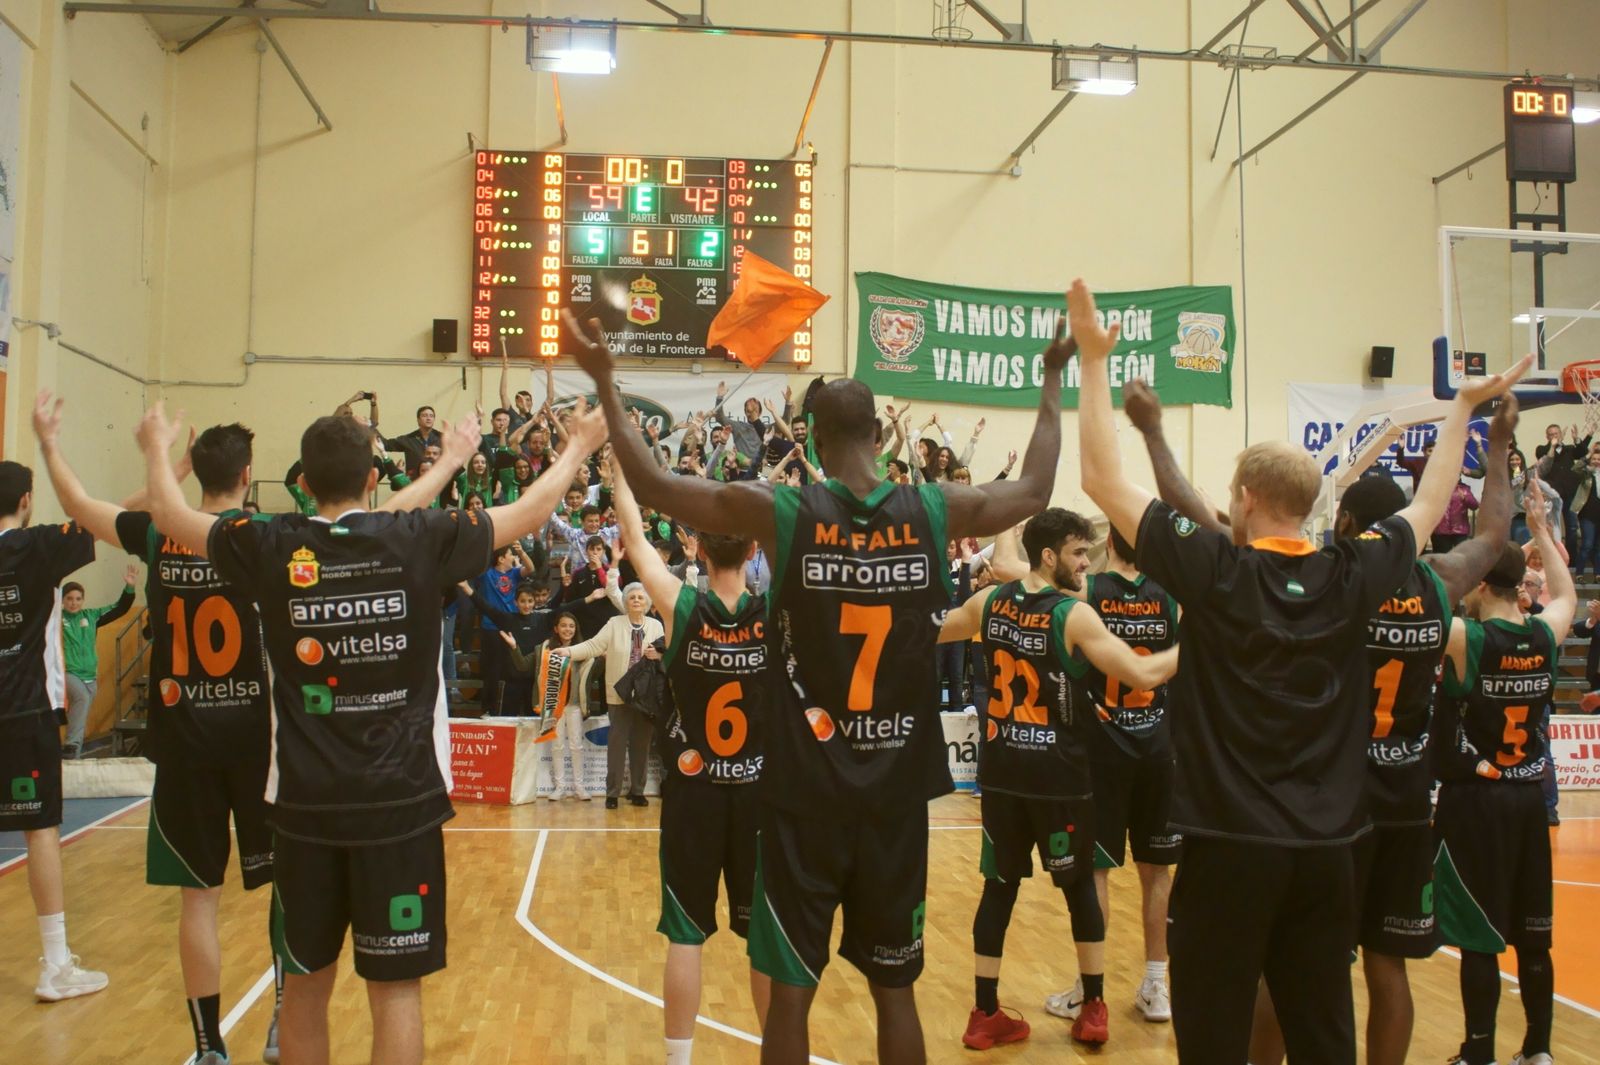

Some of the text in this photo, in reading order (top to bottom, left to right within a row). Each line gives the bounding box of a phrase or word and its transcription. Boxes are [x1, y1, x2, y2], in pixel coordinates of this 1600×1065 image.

[1554, 94, 1566, 114] 0
[477, 152, 494, 165] 01
[666, 160, 682, 184] 0
[729, 161, 811, 176] 03 05
[477, 169, 562, 185] 04 00
[476, 187, 493, 199] 05
[729, 178, 811, 193] 07 10
[589, 186, 623, 210] 59
[636, 186, 652, 212] E
[685, 188, 718, 212] 42
[729, 194, 811, 210] 09 16
[476, 203, 561, 219] 06 00
[582, 212, 610, 222] LOCAL
[630, 213, 656, 223] PARTE
[670, 214, 714, 224] VISITANTE
[734, 212, 811, 226] 10 00
[476, 220, 492, 232] 07
[480, 238, 491, 250] 10
[588, 228, 604, 254] 5
[632, 230, 649, 254] 6
[668, 231, 673, 255] 1
[700, 231, 719, 256] 2
[734, 229, 811, 244] 11 04
[572, 256, 598, 265] FALTAS
[733, 246, 810, 260] 12 03
[480, 256, 560, 270] 11 00
[618, 257, 644, 266] DORSAL
[654, 258, 673, 266] FALTA
[687, 259, 713, 268] FALTAS
[480, 272, 491, 284] 12
[479, 290, 490, 301] 14
[474, 306, 490, 319] 32
[934, 299, 1026, 338] VAMOS
[474, 324, 558, 338] 33 00
[604, 331, 690, 342] yuntamiento de
[473, 341, 558, 356] 99 00
[630, 344, 644, 353] de
[646, 344, 656, 354] la
[660, 344, 706, 354] Frontera
[932, 348, 1024, 388] VAMOS
[162, 566, 218, 582] arron
[807, 562, 924, 584] arrones
[294, 596, 402, 620] arrones
[991, 599, 1050, 628] VÁZUEZ
[167, 596, 242, 677] 10
[1107, 623, 1164, 636] rrones
[1368, 626, 1439, 644] rones
[327, 632, 407, 656] vitelsa
[840, 602, 893, 711] 7
[185, 678, 260, 700] vitelsa
[988, 649, 1048, 726] 32
[1484, 678, 1550, 692] arrones
[336, 688, 408, 704] minuscenter
[1372, 658, 1404, 738] 1
[706, 681, 748, 756] 6
[838, 712, 914, 740] vitels
[450, 730, 494, 740] TUNIDADES
[1002, 724, 1056, 744] vitelsa
[1496, 706, 1530, 766] 5
[1572, 776, 1600, 787] Depo
[243, 852, 274, 865] minusc
[354, 932, 431, 948] minuscenter
